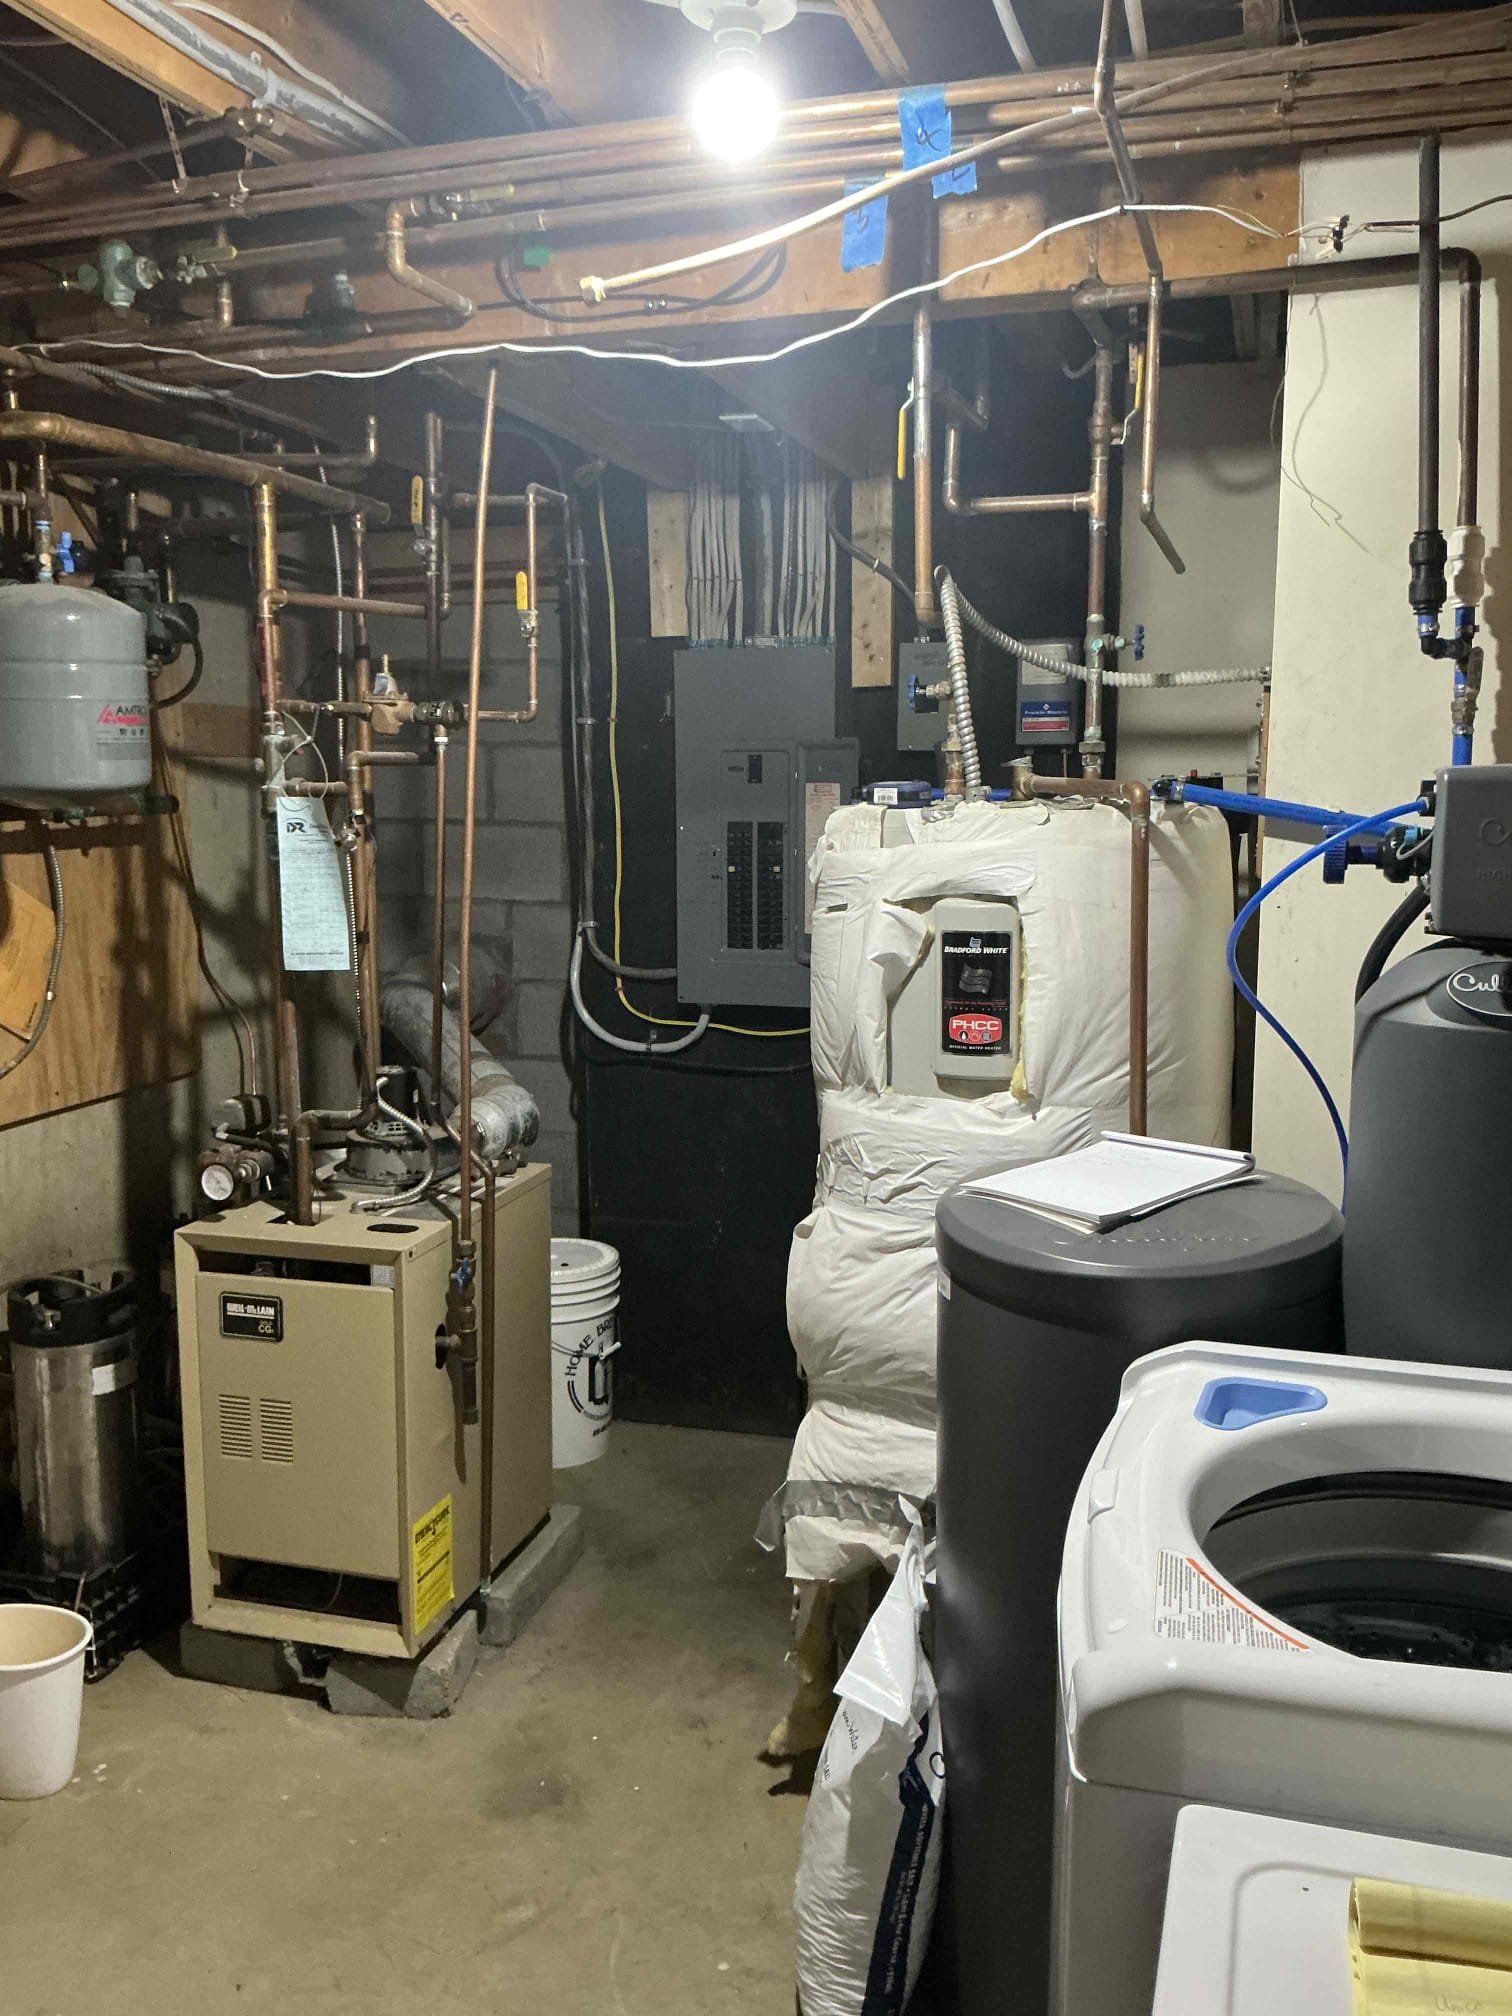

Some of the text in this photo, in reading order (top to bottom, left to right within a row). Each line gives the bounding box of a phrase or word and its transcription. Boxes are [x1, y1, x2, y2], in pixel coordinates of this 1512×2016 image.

[944, 945, 1008, 954] BRADFORD WHITE
[952, 1019, 1000, 1031] PHCC
[565, 1334, 594, 1377] HOME
